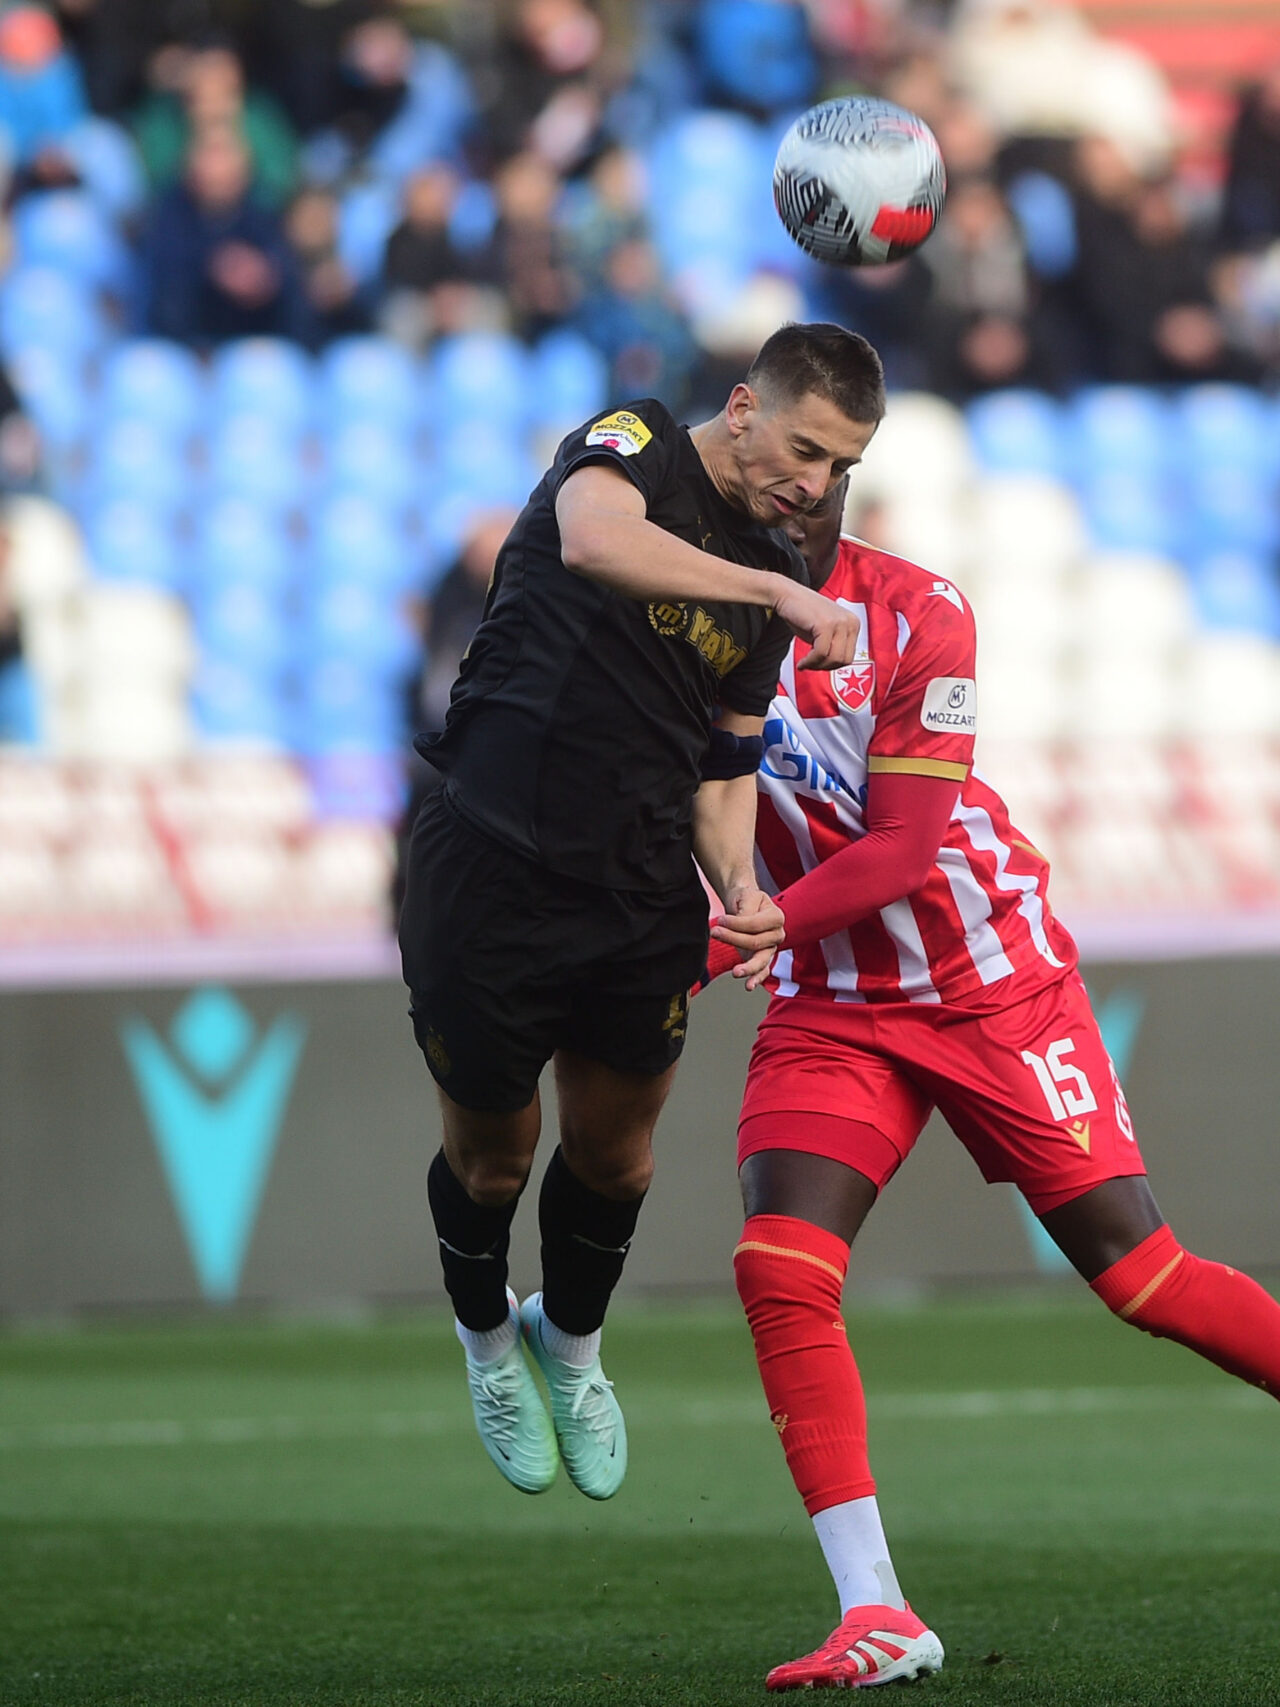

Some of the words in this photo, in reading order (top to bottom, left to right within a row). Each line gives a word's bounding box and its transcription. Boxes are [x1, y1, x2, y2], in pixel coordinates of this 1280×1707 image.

[594, 423, 644, 442] MOZZART
[685, 606, 748, 678] MAXI
[1020, 1037, 1098, 1122] 15
